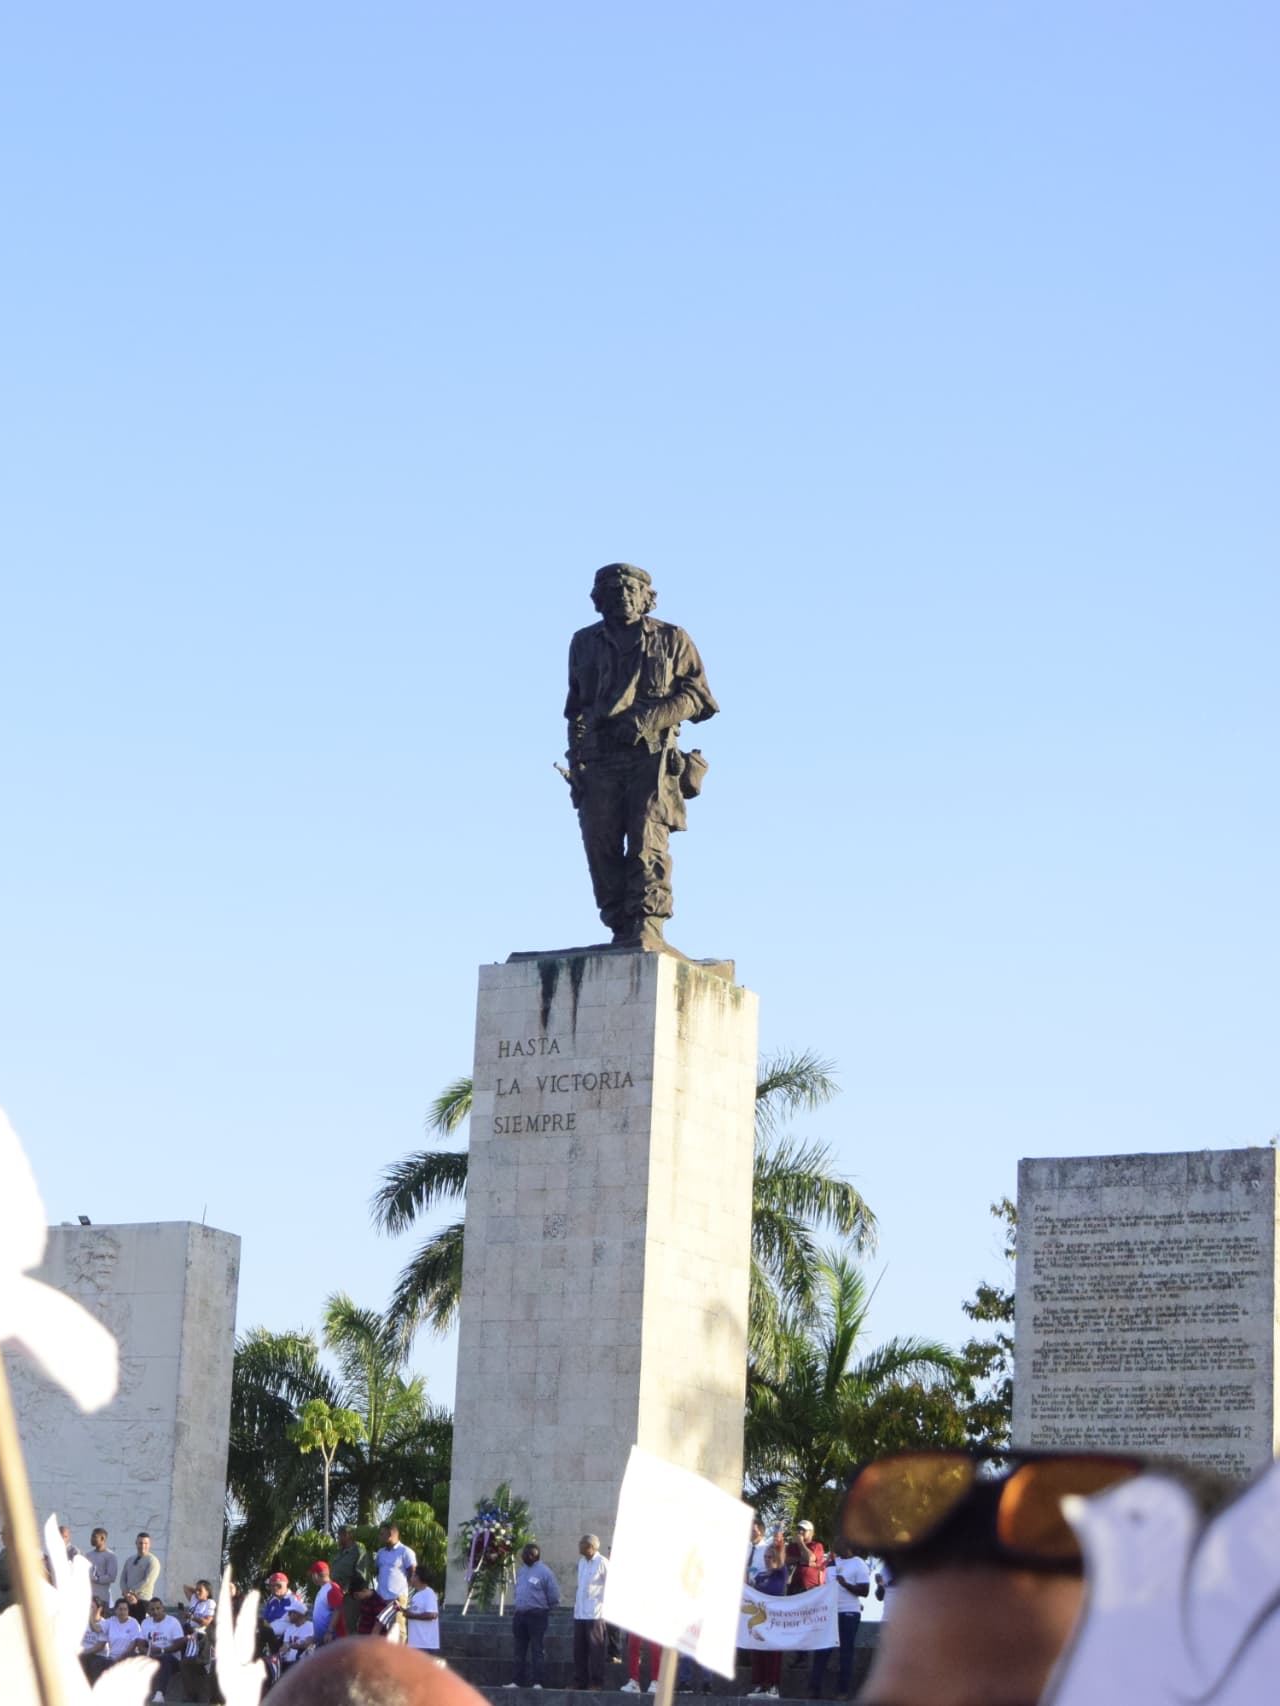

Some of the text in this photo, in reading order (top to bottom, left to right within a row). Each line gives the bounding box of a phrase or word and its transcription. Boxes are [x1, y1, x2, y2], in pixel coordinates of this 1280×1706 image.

[497, 1037, 560, 1058] HASTA
[496, 1071, 634, 1096] LA VICTORIA
[493, 1112, 577, 1134] SIEMPRE
